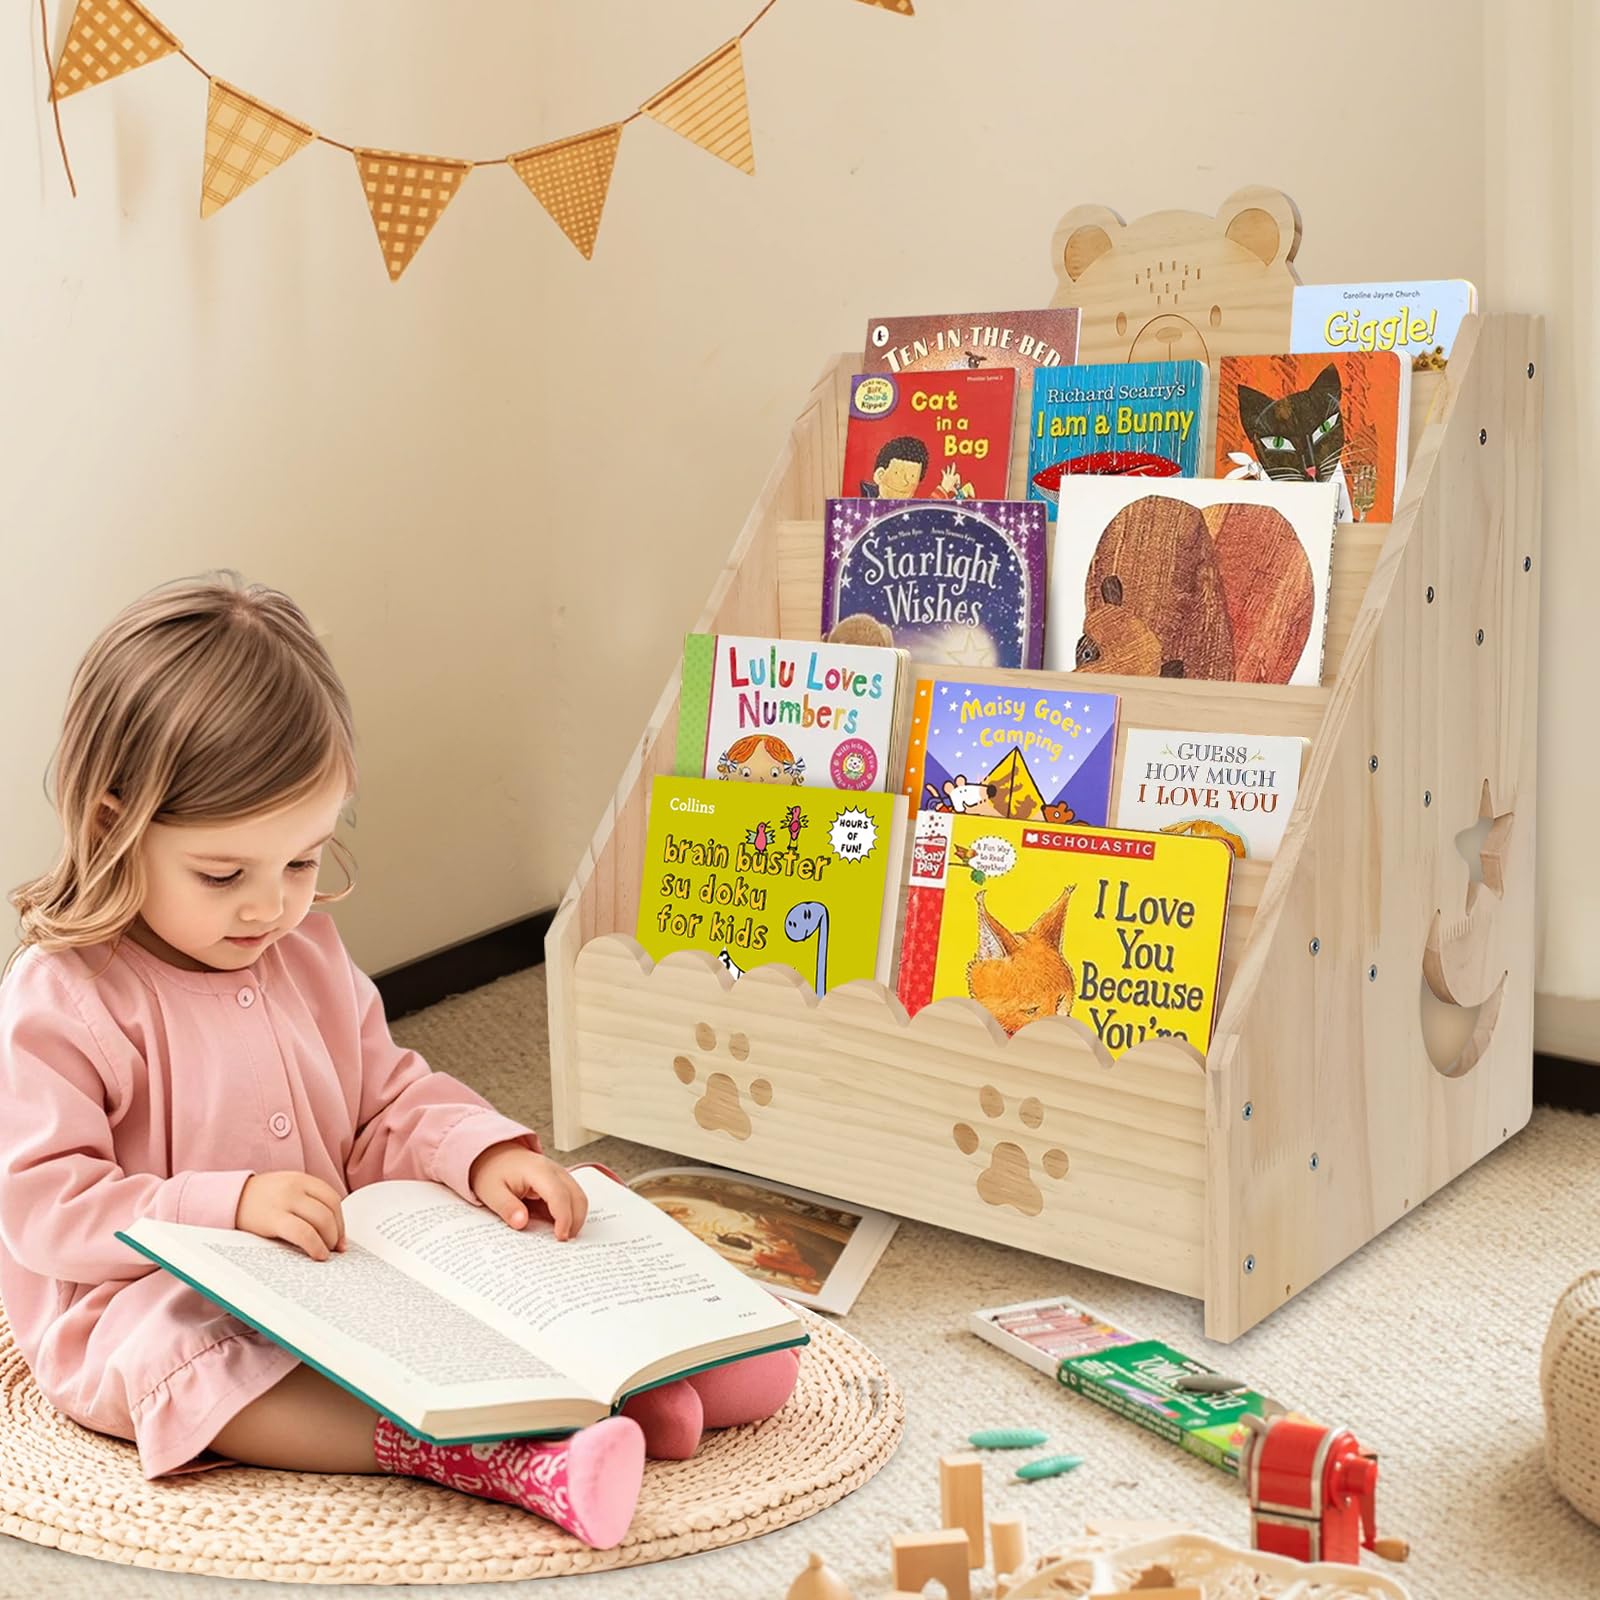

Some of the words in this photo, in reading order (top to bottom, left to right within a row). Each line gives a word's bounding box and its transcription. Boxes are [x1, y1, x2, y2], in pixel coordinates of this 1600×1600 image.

[1343, 291, 1371, 299] Caroline
[1373, 291, 1393, 300] Jayne
[1395, 290, 1420, 298] Church
[937, 328, 962, 350] IN
[970, 326, 1016, 349] THE
[1324, 305, 1438, 352] Giggle!
[911, 390, 959, 411] Cat
[1047, 386, 1115, 403] Richard
[1118, 382, 1186, 401] Scarry's
[936, 416, 951, 431] in
[957, 418, 969, 431] a
[1036, 411, 1044, 437] I
[1050, 415, 1087, 437] am
[1094, 414, 1111, 435] a
[1117, 406, 1194, 441] Bunny
[944, 434, 989, 459] Bag
[862, 536, 1001, 596] Starlight
[883, 580, 983, 628] Wishes
[729, 646, 796, 688] Lulu
[806, 652, 883, 699] Loves
[738, 690, 859, 734] Numbers
[960, 696, 1026, 724] Maisy
[1034, 699, 1082, 738] Goes
[980, 727, 1064, 762] Camping
[1177, 742, 1248, 764] GUESS
[1145, 762, 1200, 783] HOW
[1206, 767, 1276, 788] MUCH
[670, 797, 715, 814] Collins
[1137, 784, 1147, 803] I
[1155, 785, 1219, 809] LOVE
[1227, 790, 1279, 813] YOU
[839, 819, 869, 830] HOURS
[847, 832, 858, 841] OF
[663, 834, 729, 869] brain
[735, 842, 831, 881] buster
[841, 843, 862, 854] FUN!
[914, 846, 945, 862] Story
[1041, 834, 1153, 855] SCHOLASTIC
[660, 873, 691, 899] su
[699, 874, 767, 911] doku
[1094, 879, 1109, 919] I
[1115, 880, 1195, 928] Love
[657, 904, 703, 938] for
[709, 911, 769, 950] kids
[1117, 927, 1174, 973] You
[1078, 960, 1204, 1012] Because
